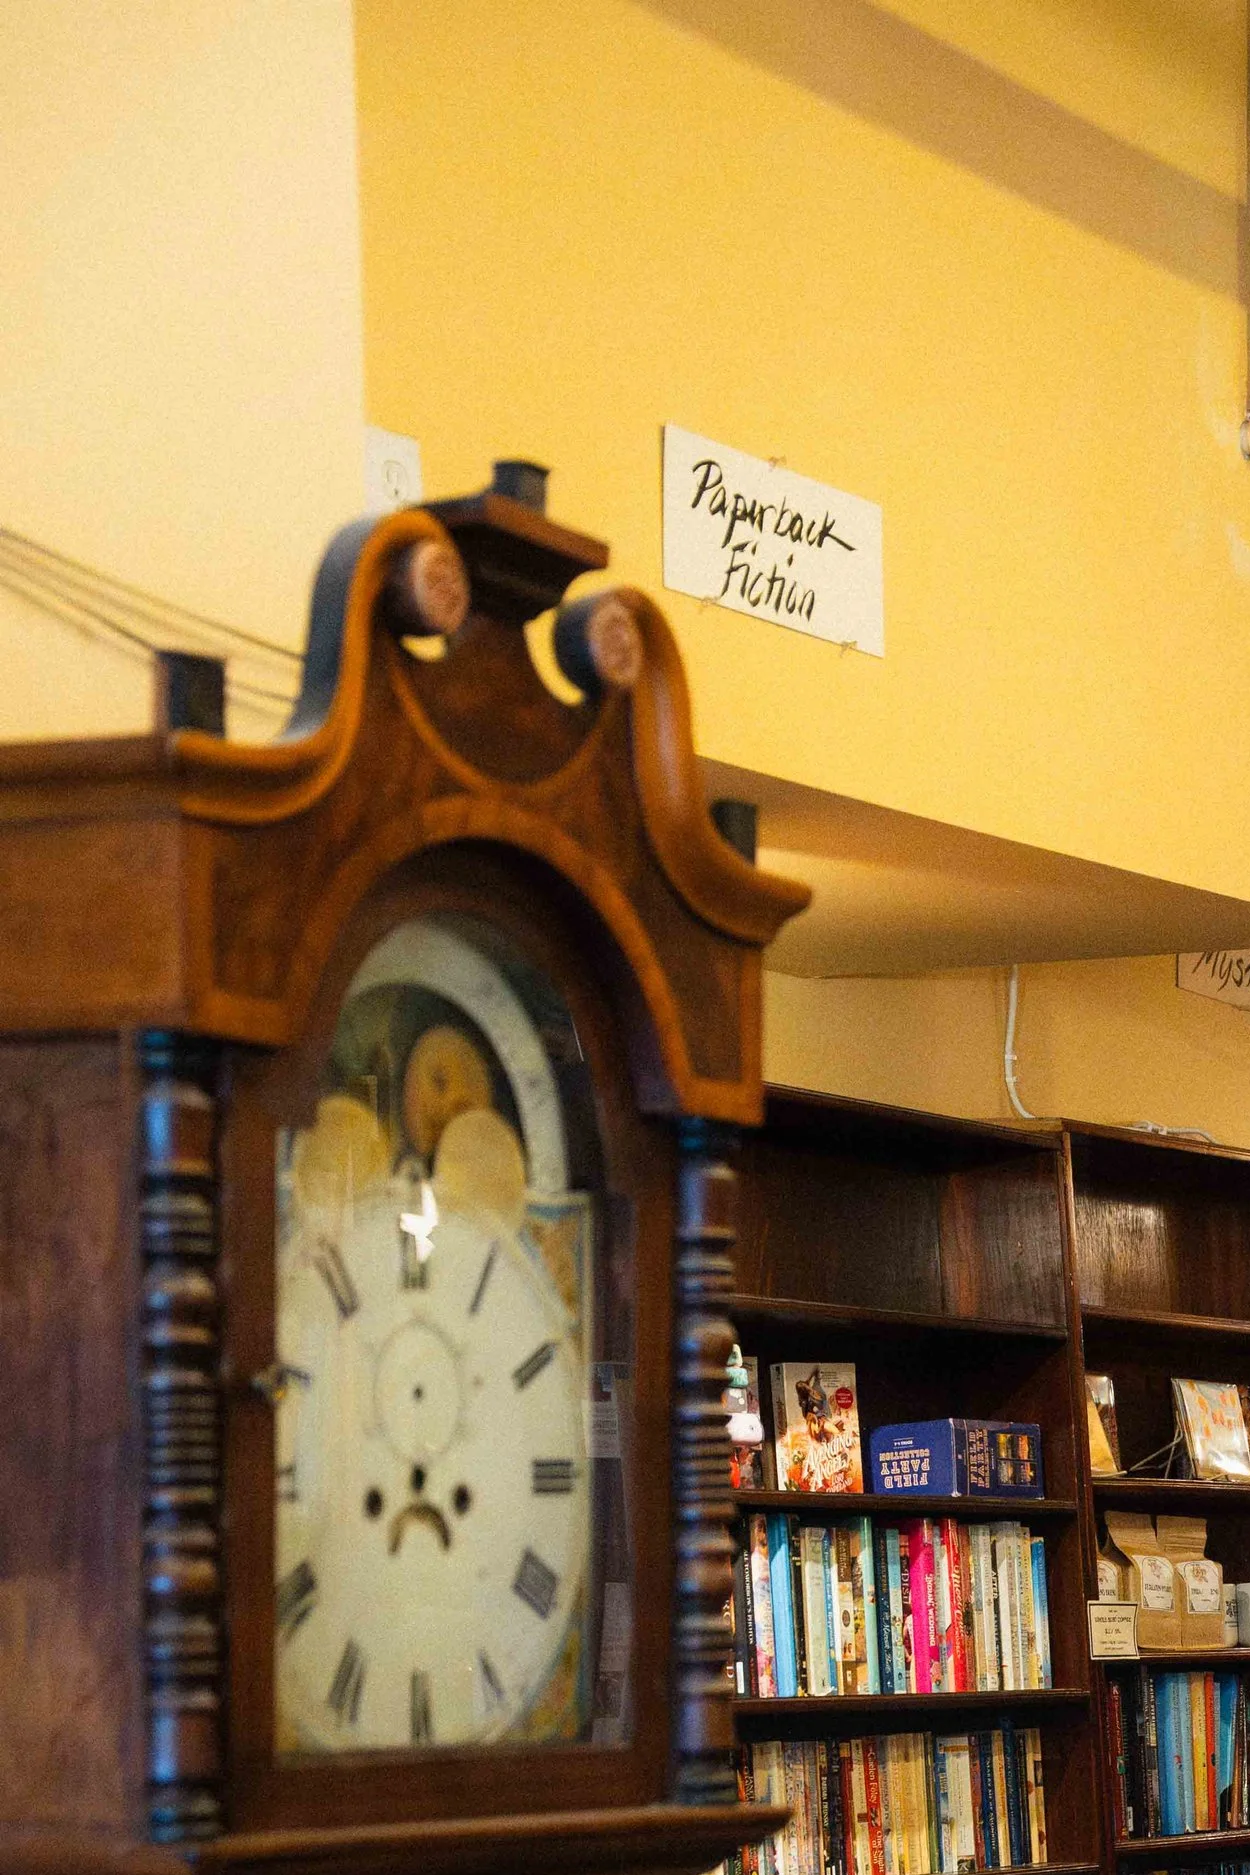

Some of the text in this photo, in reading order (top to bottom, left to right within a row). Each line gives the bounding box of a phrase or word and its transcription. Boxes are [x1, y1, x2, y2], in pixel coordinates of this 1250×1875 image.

[692, 460, 857, 550] Paperback
[721, 541, 816, 621] Fiction
[879, 1449, 931, 1462] COLLECTION
[881, 1460, 930, 1475] PARTY
[884, 1474, 928, 1489] FIELD
[744, 1563, 752, 1613] TOMORROW'S
[901, 1570, 910, 1604] DISH
[928, 1608, 936, 1647] WEDDING
[867, 1751, 879, 1804] Gaelen Foley
[872, 1840, 878, 1849] of
[877, 1850, 885, 1872] Night
